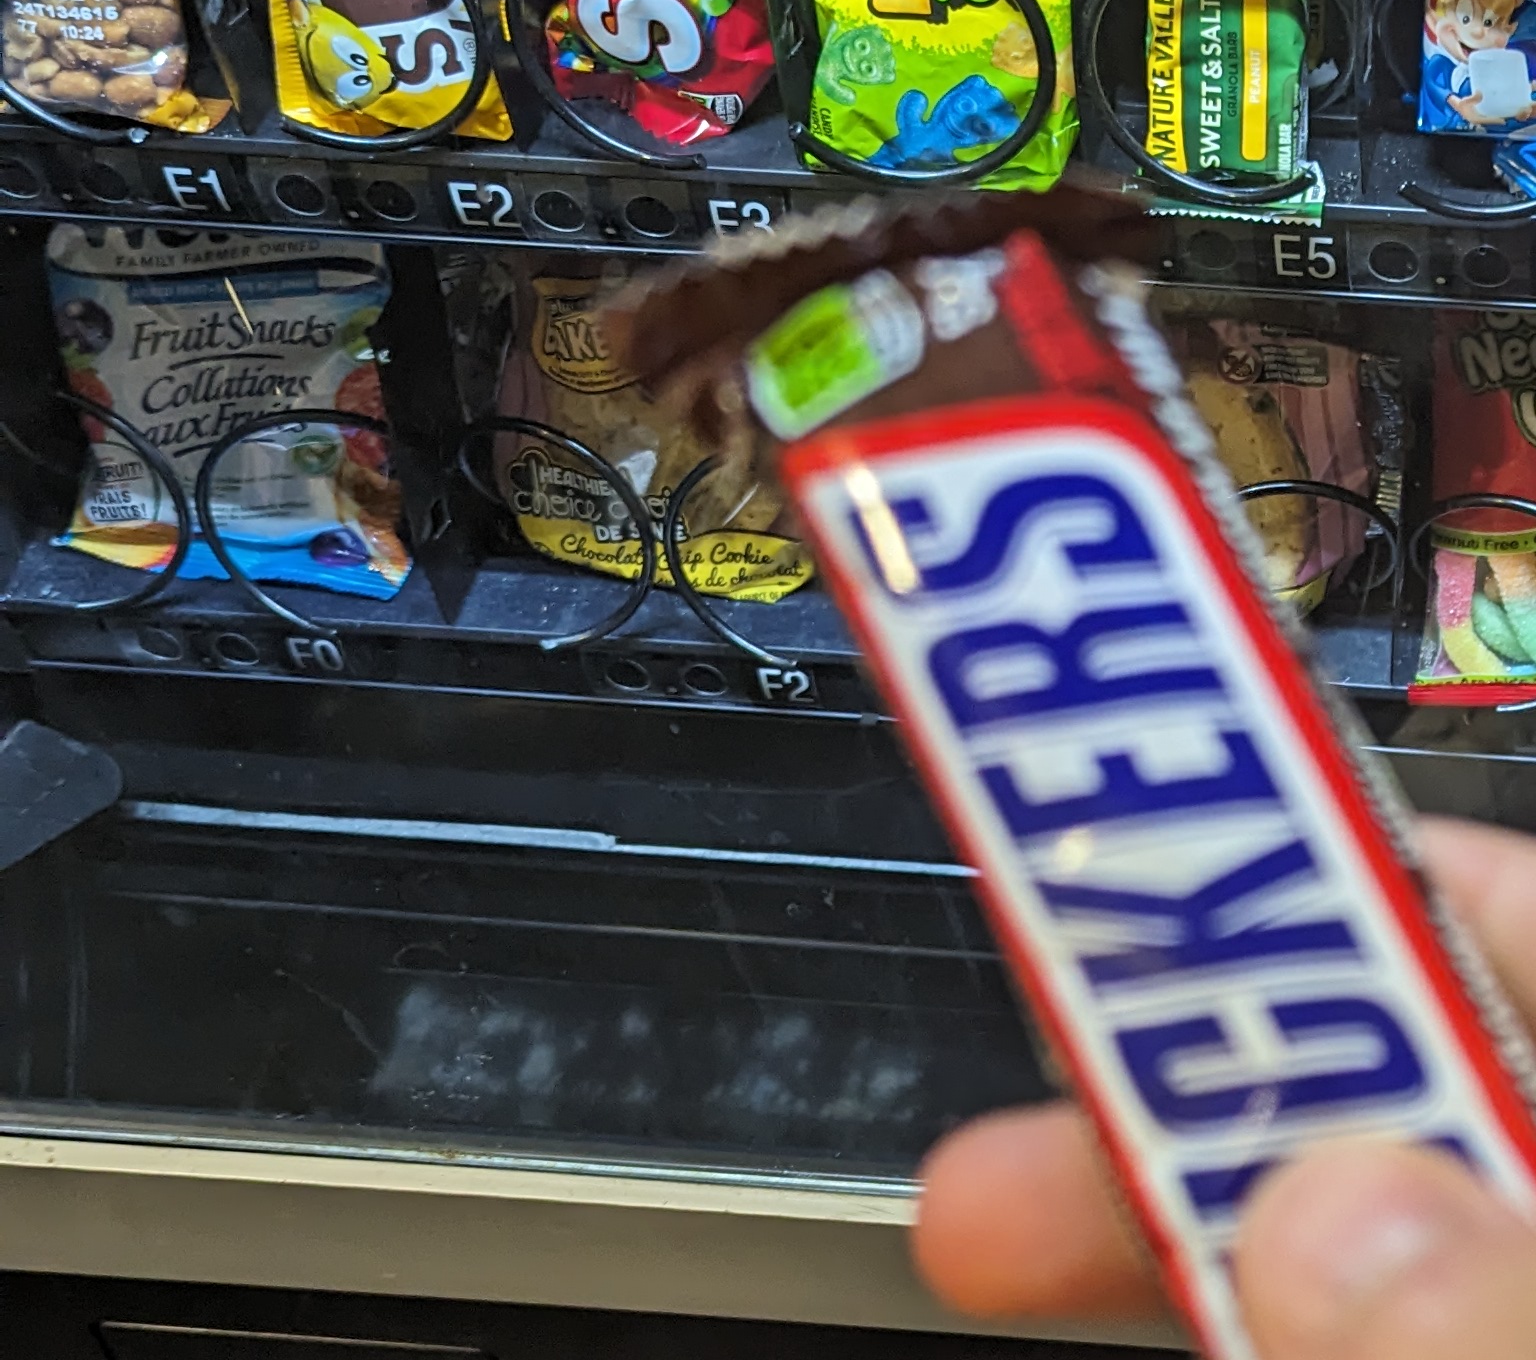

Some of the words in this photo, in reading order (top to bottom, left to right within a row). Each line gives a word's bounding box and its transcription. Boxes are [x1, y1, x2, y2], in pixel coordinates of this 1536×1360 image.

[60, 25, 105, 40] 10:24
[1228, 31, 1238, 61] BARS
[1228, 62, 1238, 118] GRANOLA
[1250, 50, 1261, 104] PEANUT
[1151, 68, 1177, 163] NATURE
[1199, 83, 1223, 169] SWEET
[162, 166, 231, 212] E1
[448, 181, 514, 228] E2
[710, 200, 773, 238] E3
[116, 255, 177, 269] FAMILY
[183, 247, 251, 265] FARMER
[1273, 235, 1337, 280] E5
[129, 312, 225, 361] Fruit
[222, 314, 337, 349] Snacks
[141, 365, 313, 415] Collations
[143, 420, 210, 447] aux
[513, 486, 601, 521] choice
[596, 525, 616, 540] DE
[1484, 537, 1520, 551] Free
[709, 542, 774, 566] Cookie
[287, 638, 345, 673] F0
[758, 669, 811, 702] F2
